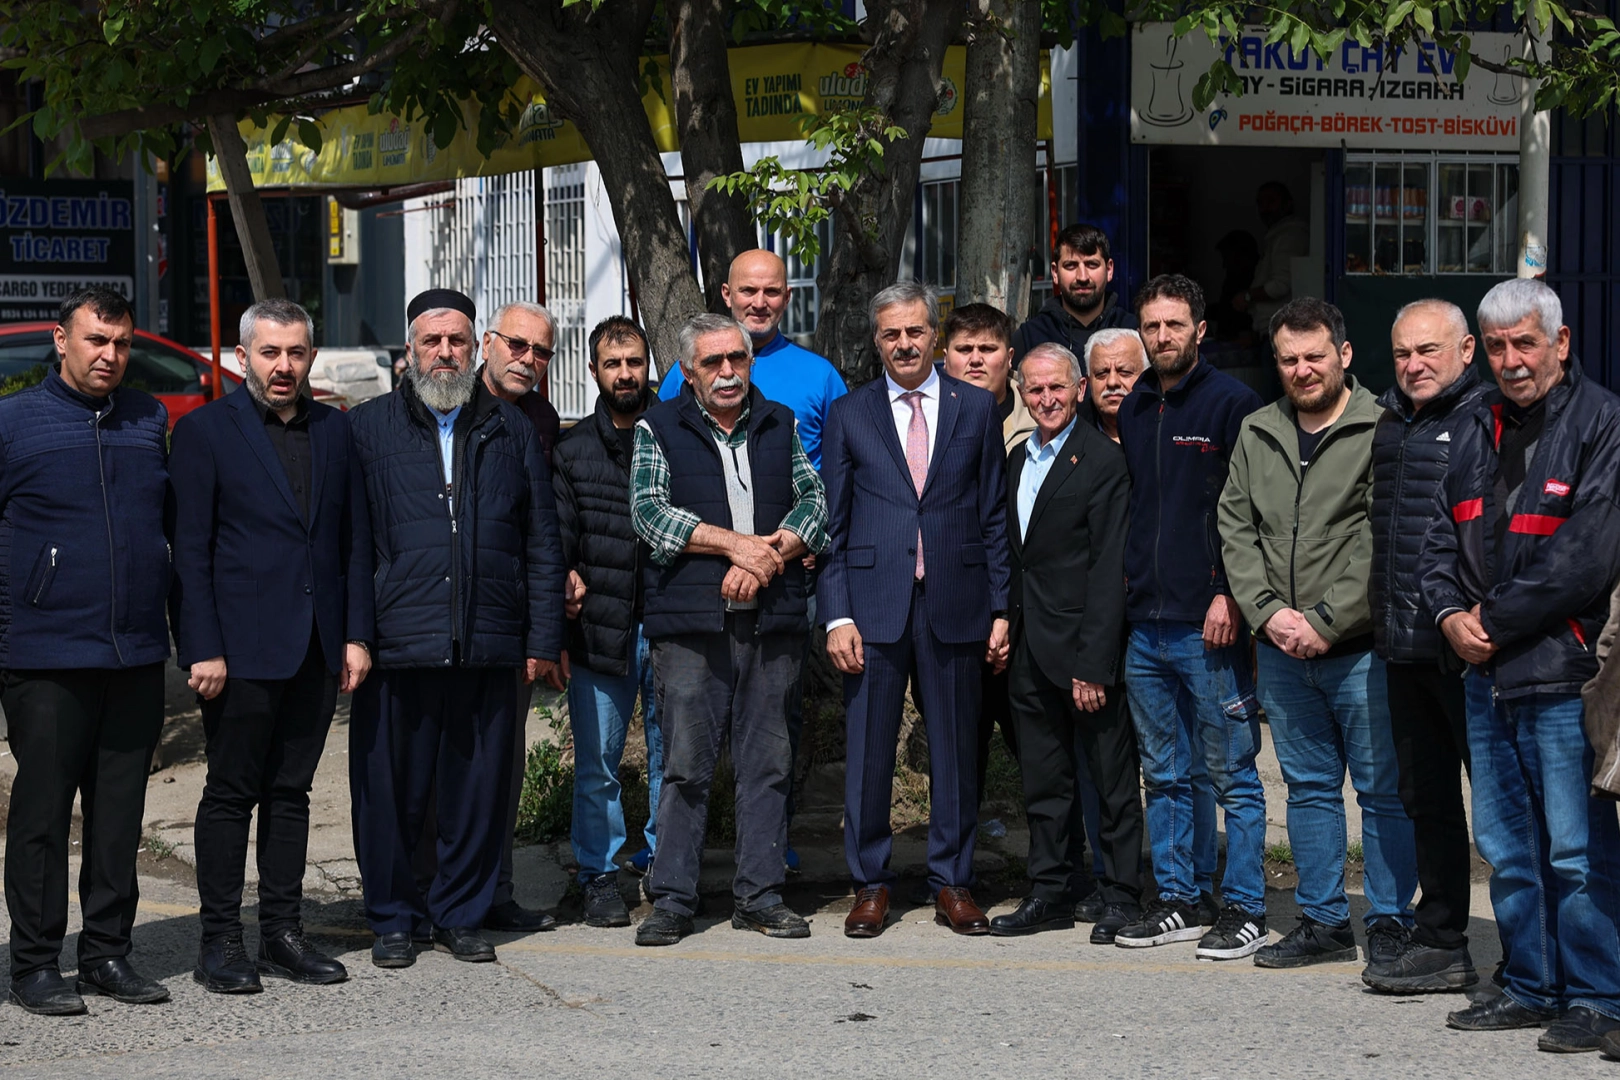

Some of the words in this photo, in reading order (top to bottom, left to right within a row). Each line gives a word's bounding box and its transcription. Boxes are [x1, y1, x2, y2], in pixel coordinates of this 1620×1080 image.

[1218, 36, 1328, 71] YAKU
[745, 78, 760, 96] EV
[763, 74, 802, 93] YAPIMI
[819, 71, 868, 97] ulud
[745, 93, 803, 118] TADINDA
[10, 231, 110, 263] TİCARET
